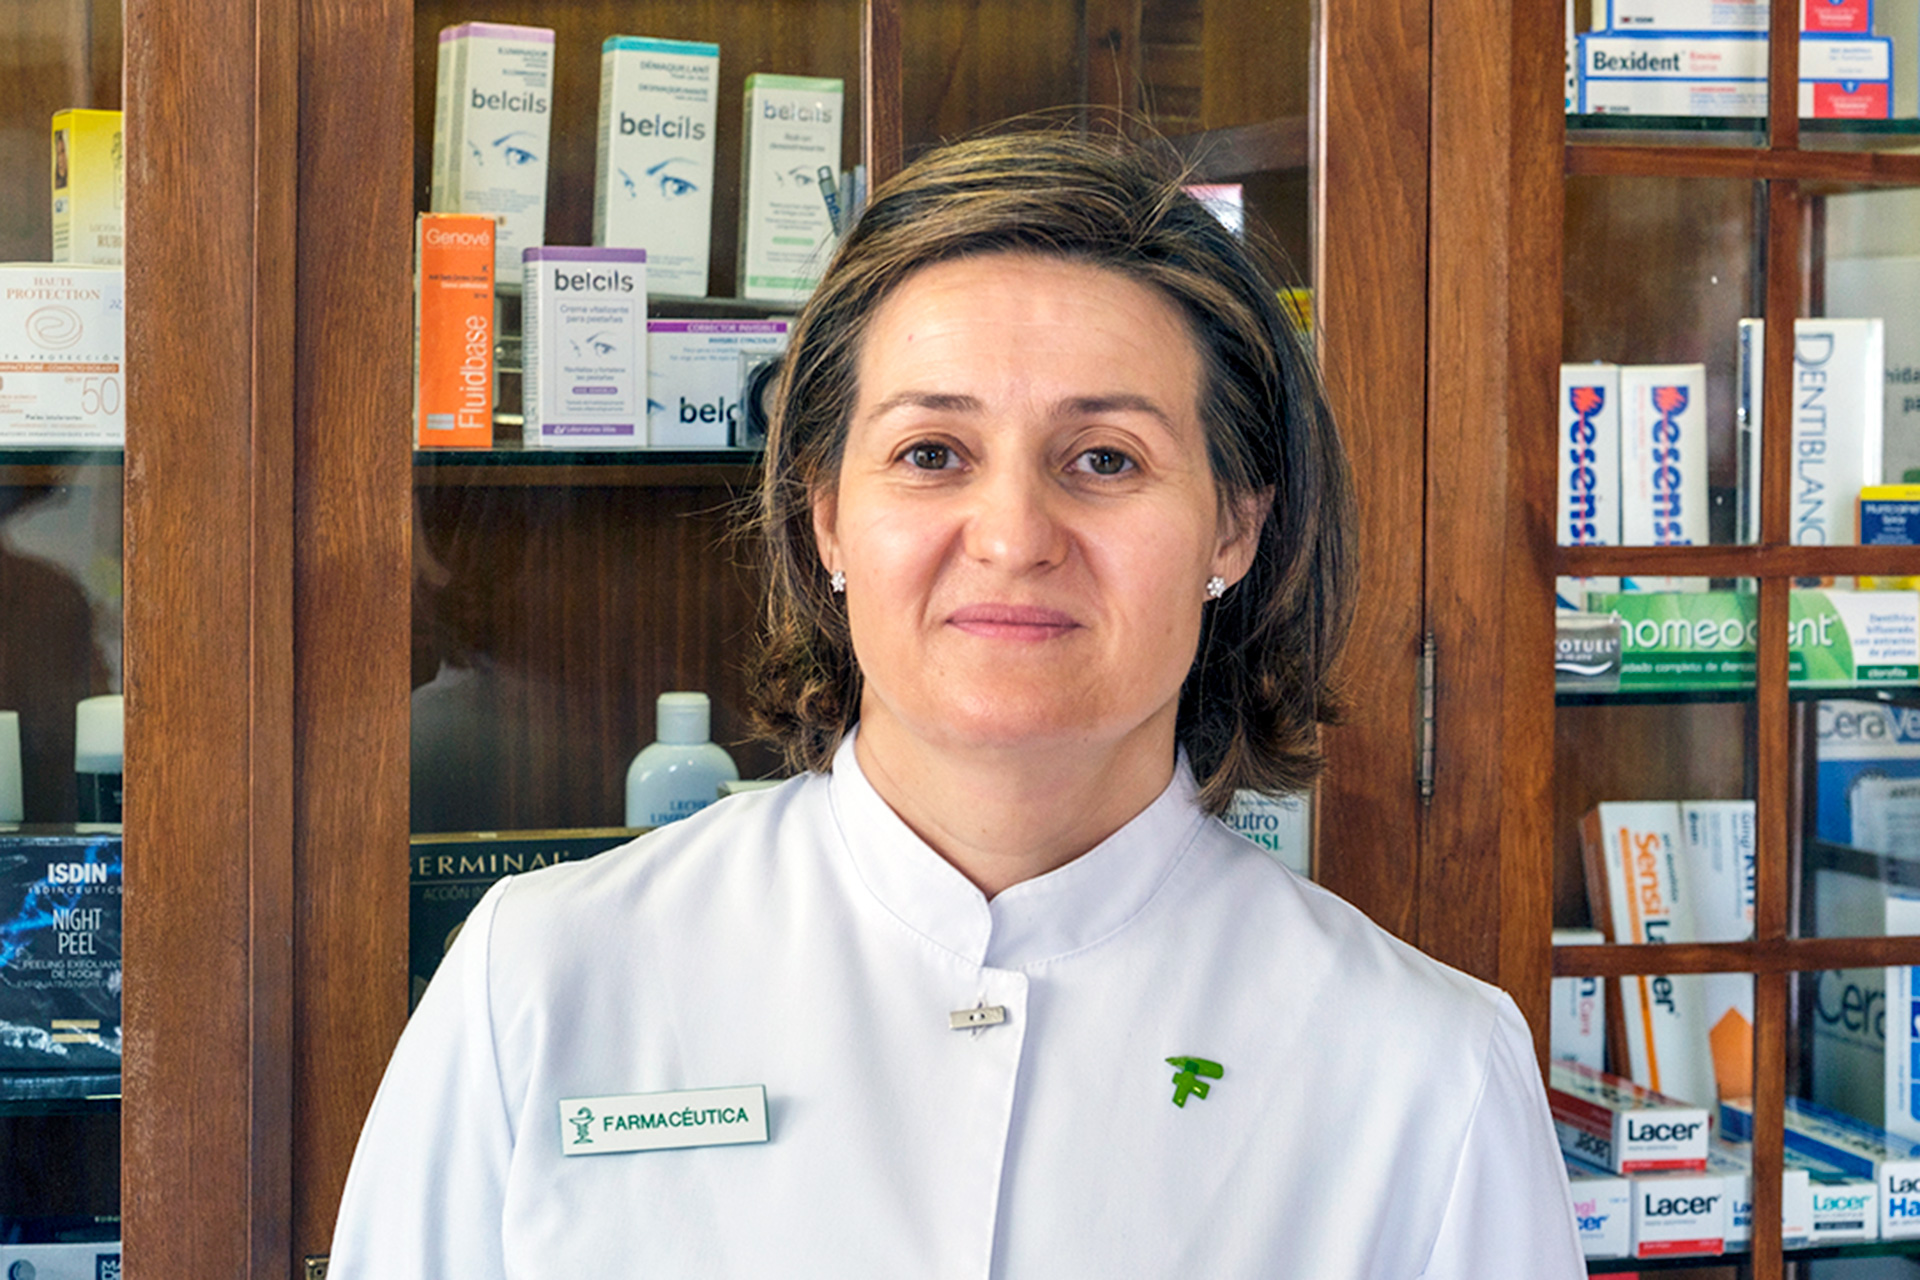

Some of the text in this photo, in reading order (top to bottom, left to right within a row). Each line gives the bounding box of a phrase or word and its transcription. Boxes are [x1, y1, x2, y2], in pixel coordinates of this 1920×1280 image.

[1593, 52, 1681, 71] Bexident
[472, 88, 547, 114] belcils
[763, 100, 832, 123] belcils
[619, 112, 705, 140] belcils
[426, 228, 490, 247] Genové
[34, 277, 74, 287] HAUTE
[555, 269, 633, 293] belcils
[6, 288, 101, 300] PROTECTION
[458, 315, 487, 428] Fluidbase
[81, 376, 119, 415] 50
[1569, 386, 1605, 546] Desens
[1651, 386, 1692, 546] Desens
[1556, 640, 1610, 653] OTUEL
[48, 863, 107, 884] ISDIN
[1635, 833, 1670, 915] Sensi
[52, 909, 102, 931] NIGHT
[58, 932, 96, 955] PEEL
[603, 1107, 749, 1132] FARMACÉUTICA
[1628, 1120, 1699, 1141] Lacer
[1645, 1194, 1718, 1217] Lacer
[1814, 1194, 1867, 1211] Lacer
